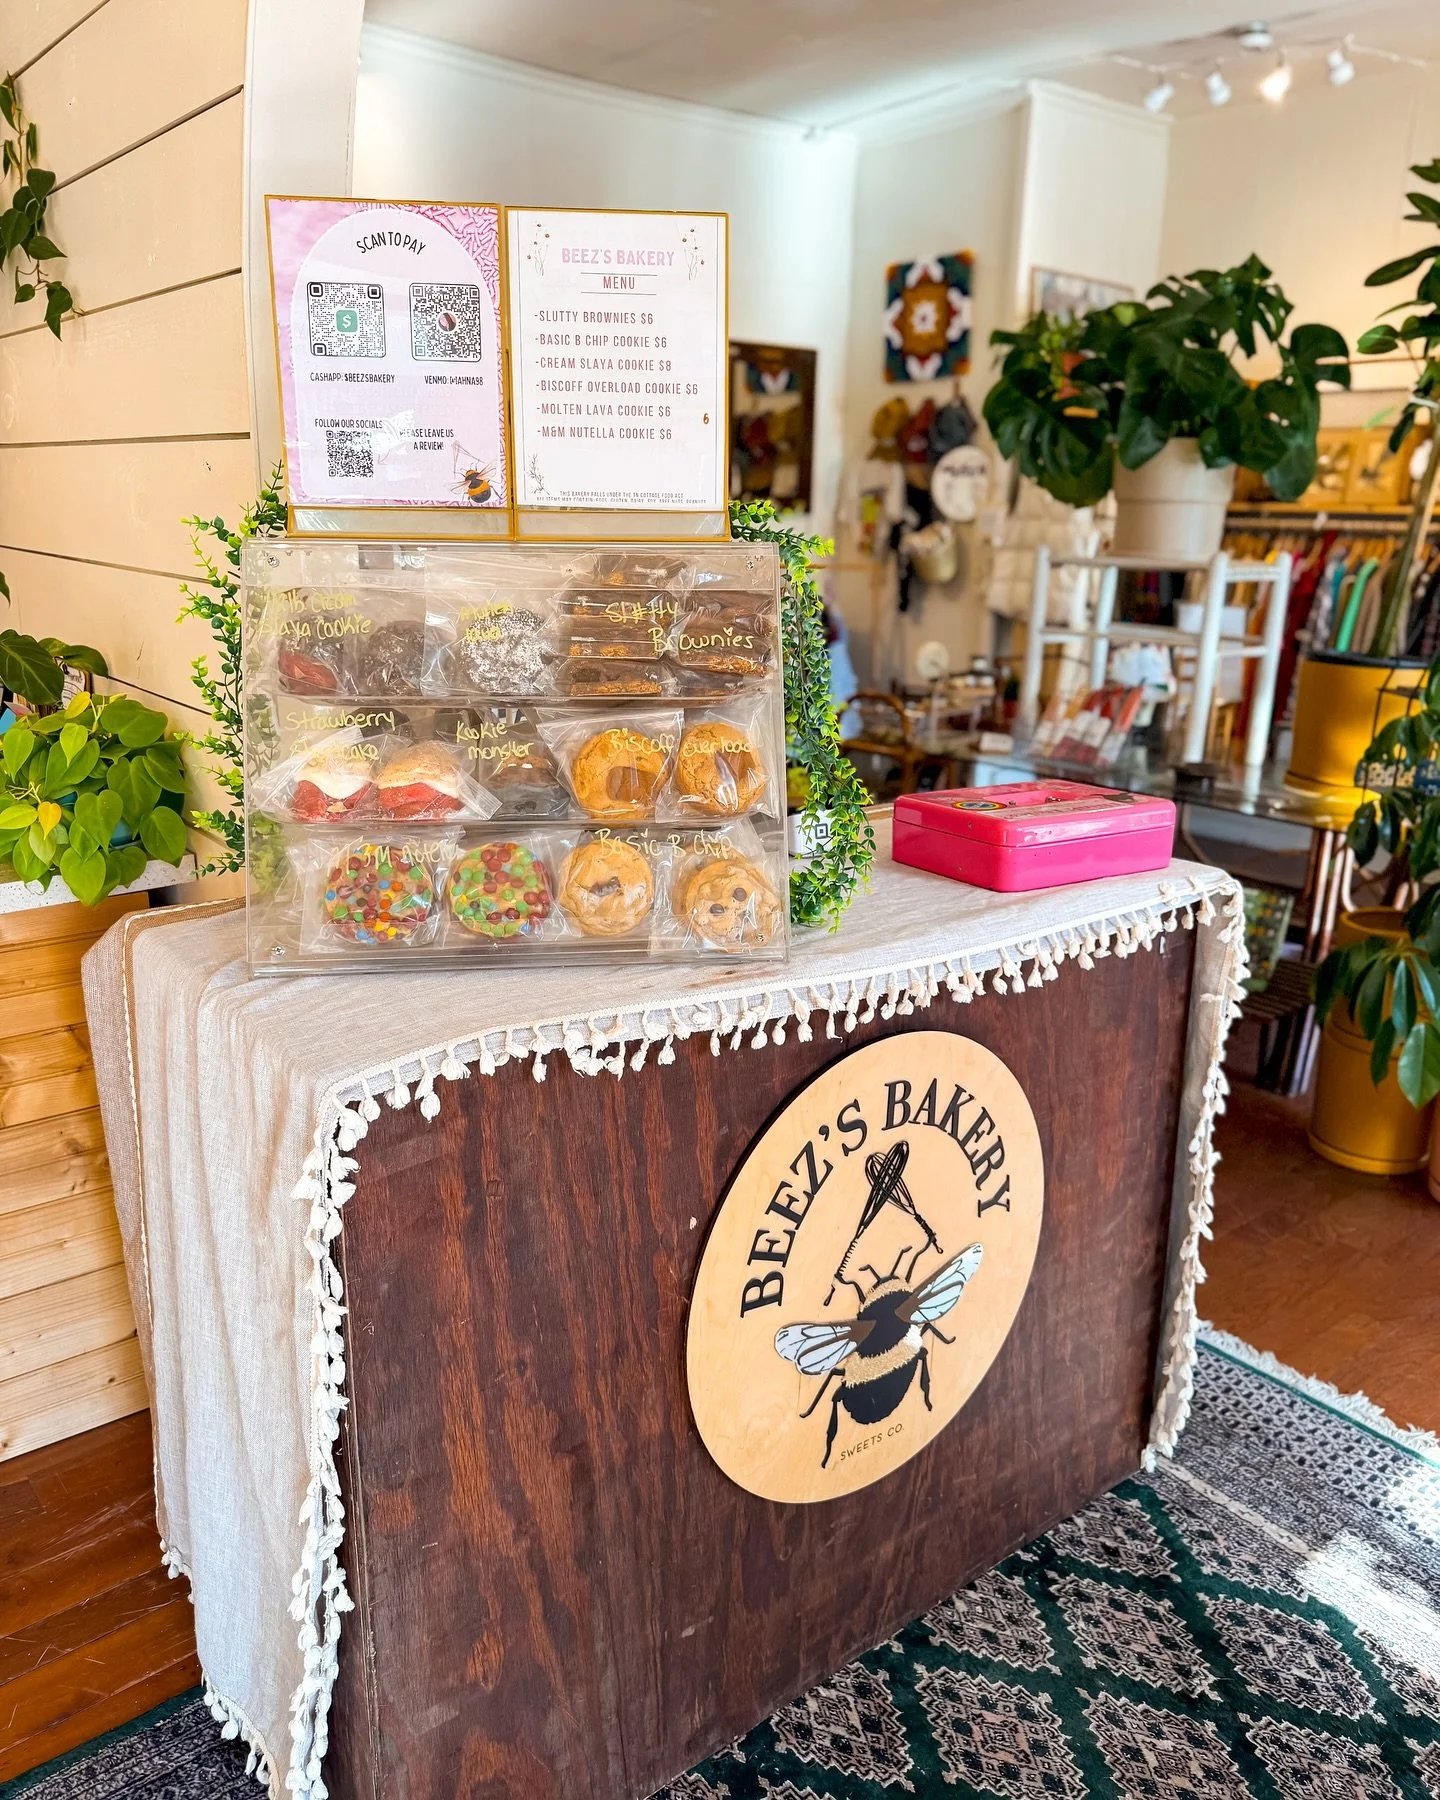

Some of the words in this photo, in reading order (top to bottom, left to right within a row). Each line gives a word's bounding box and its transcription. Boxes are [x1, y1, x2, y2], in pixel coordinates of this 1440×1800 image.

[356, 231, 387, 254] SCAN
[388, 231, 402, 247] TO
[402, 234, 427, 255] PAY
[561, 248, 613, 264] BEEZ'S
[616, 249, 675, 267] BAKERY
[603, 276, 636, 290] MENU
[534, 310, 579, 322] -SLUTTY
[583, 311, 636, 324] BROWNIES
[640, 312, 654, 324] $6
[535, 333, 571, 346] -BASIC
[575, 334, 582, 346] B
[585, 335, 609, 346] CHIP
[613, 336, 650, 348] COOKIE
[654, 336, 667, 348] $6
[535, 357, 576, 369] -CREAM
[580, 358, 614, 370] SLAYA
[617, 359, 654, 371] COOKIE
[658, 360, 672, 372] $8
[344, 373, 396, 384] $BEEZSBAKERY
[535, 380, 583, 392] -BISCOFF
[587, 381, 641, 393] OVERLOAD
[645, 382, 681, 394] COOKIE
[685, 383, 698, 395] $6
[536, 403, 582, 415] -MOLTEN
[586, 404, 613, 416] LAVA
[617, 405, 654, 417] COOKIE
[658, 406, 671, 417] $6
[314, 418, 341, 428] FOLLOW
[340, 419, 355, 429] OUR
[355, 420, 383, 430] SOCIALS
[424, 428, 446, 438] LEAVE
[445, 429, 455, 438] US
[537, 426, 565, 437] -M&M
[569, 427, 615, 438] NUTELLA
[619, 428, 655, 439] COOKIE
[659, 429, 672, 440] $6
[413, 441, 419, 450] A
[648, 627, 756, 653] Brownies
[284, 709, 396, 732] Strawberry
[740, 1098, 868, 1318] BEEZ'S
[881, 1077, 1011, 1218] BAKERY
[840, 1433, 882, 1461] SWEETS
